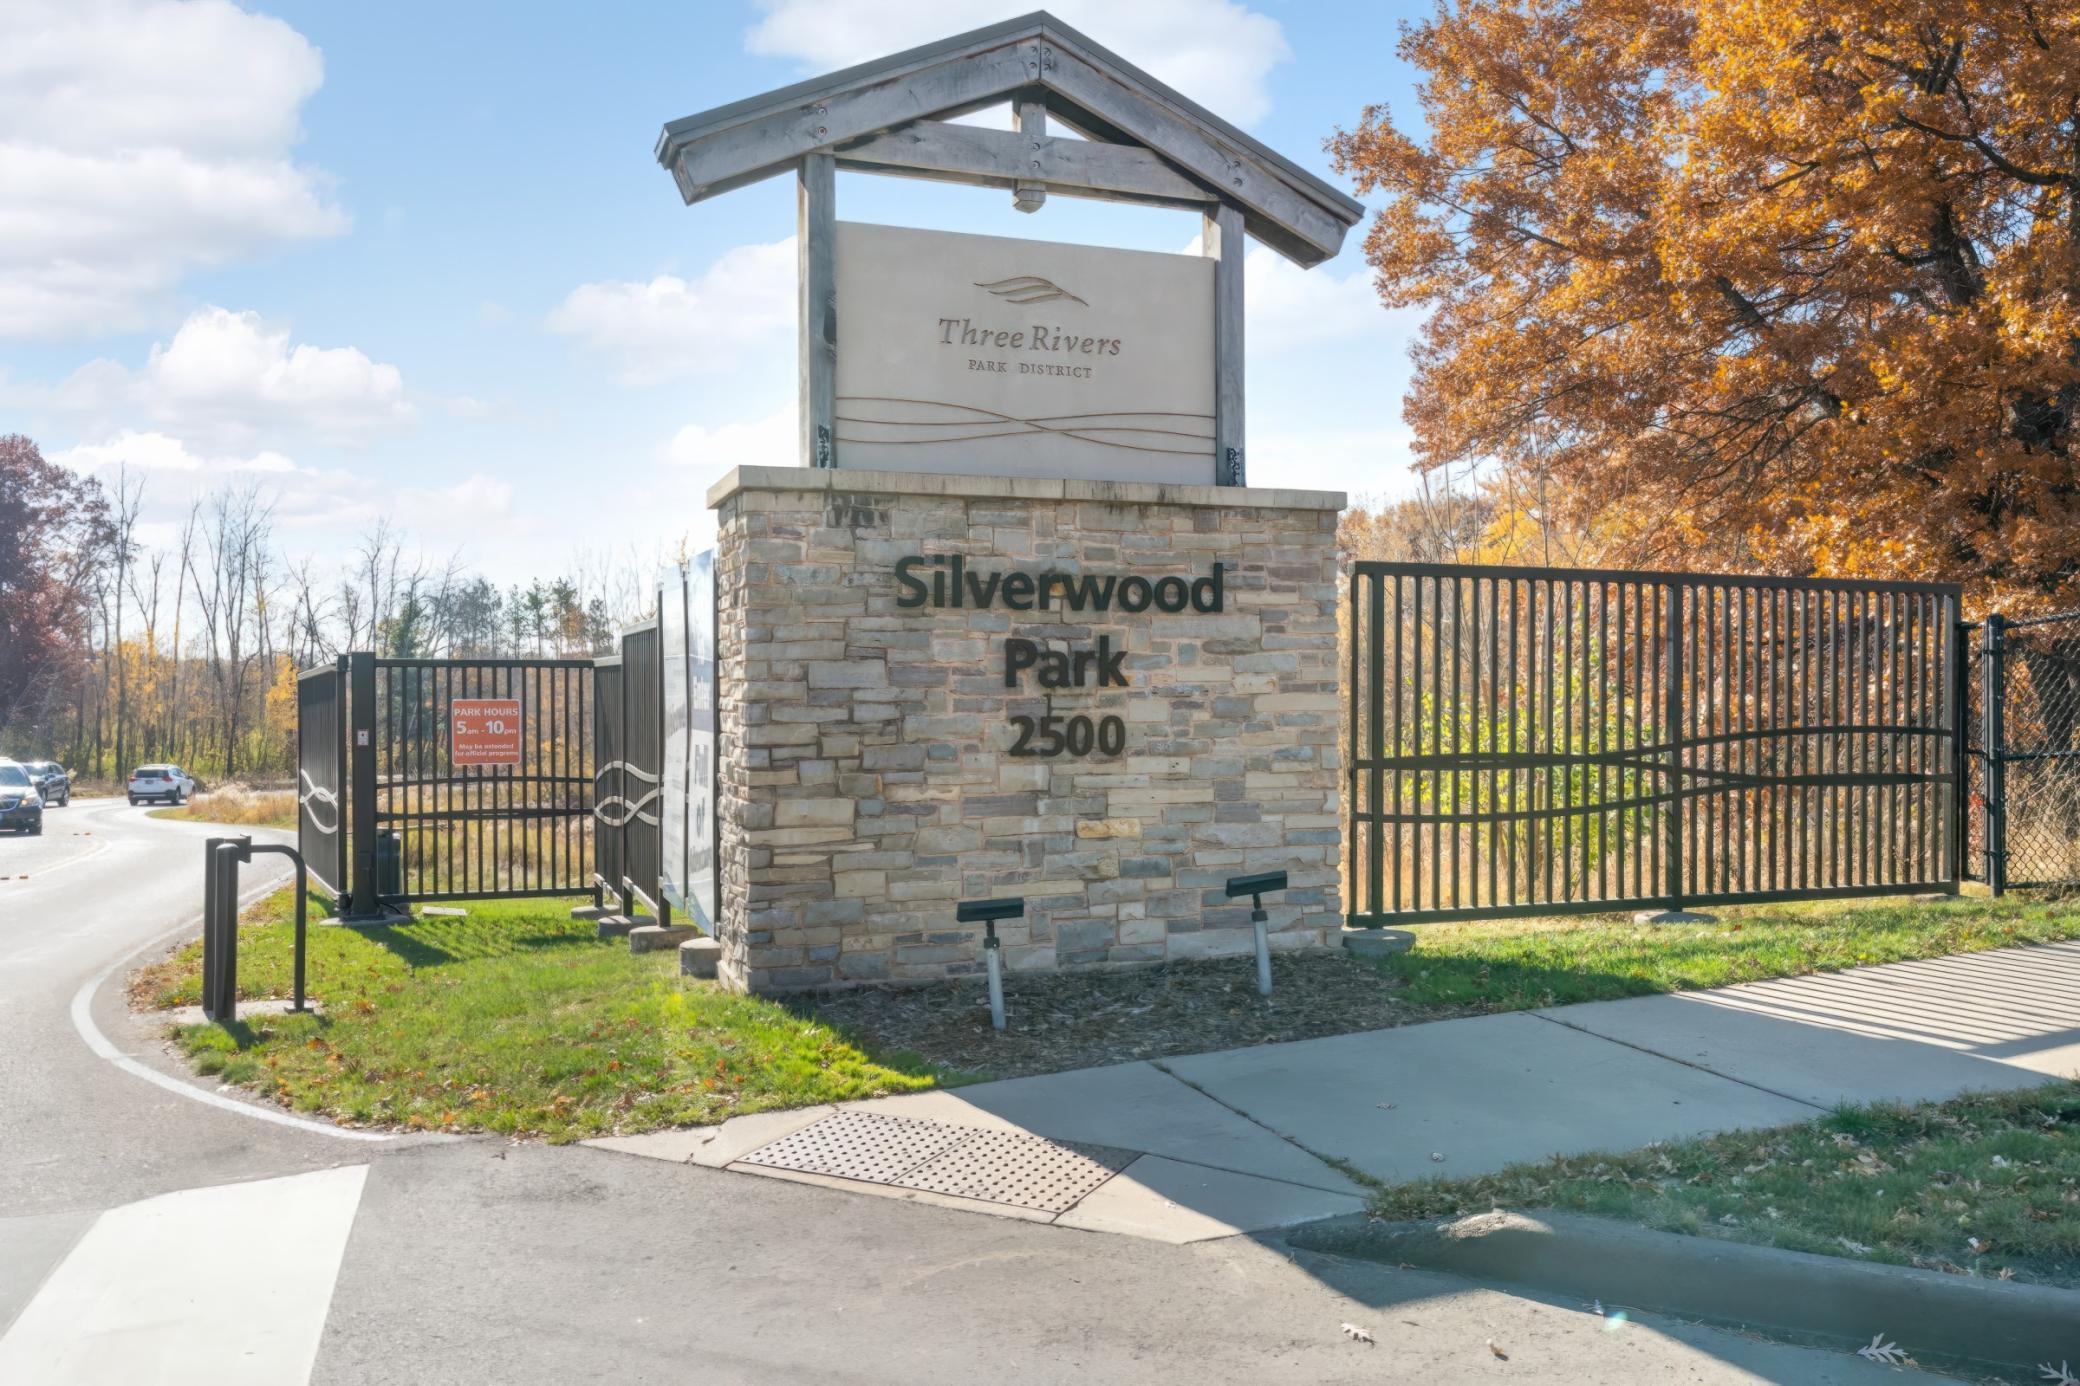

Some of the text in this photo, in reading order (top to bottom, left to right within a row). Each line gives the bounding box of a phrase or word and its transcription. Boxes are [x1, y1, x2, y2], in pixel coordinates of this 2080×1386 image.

[938, 317, 1122, 356] Three Rivers
[968, 359, 1093, 378] PARK DISTRICT
[894, 554, 1224, 613] Silverwood
[1004, 634, 1130, 689] Park
[454, 707, 518, 717] PARK HOURS
[1009, 714, 1126, 757] 2500
